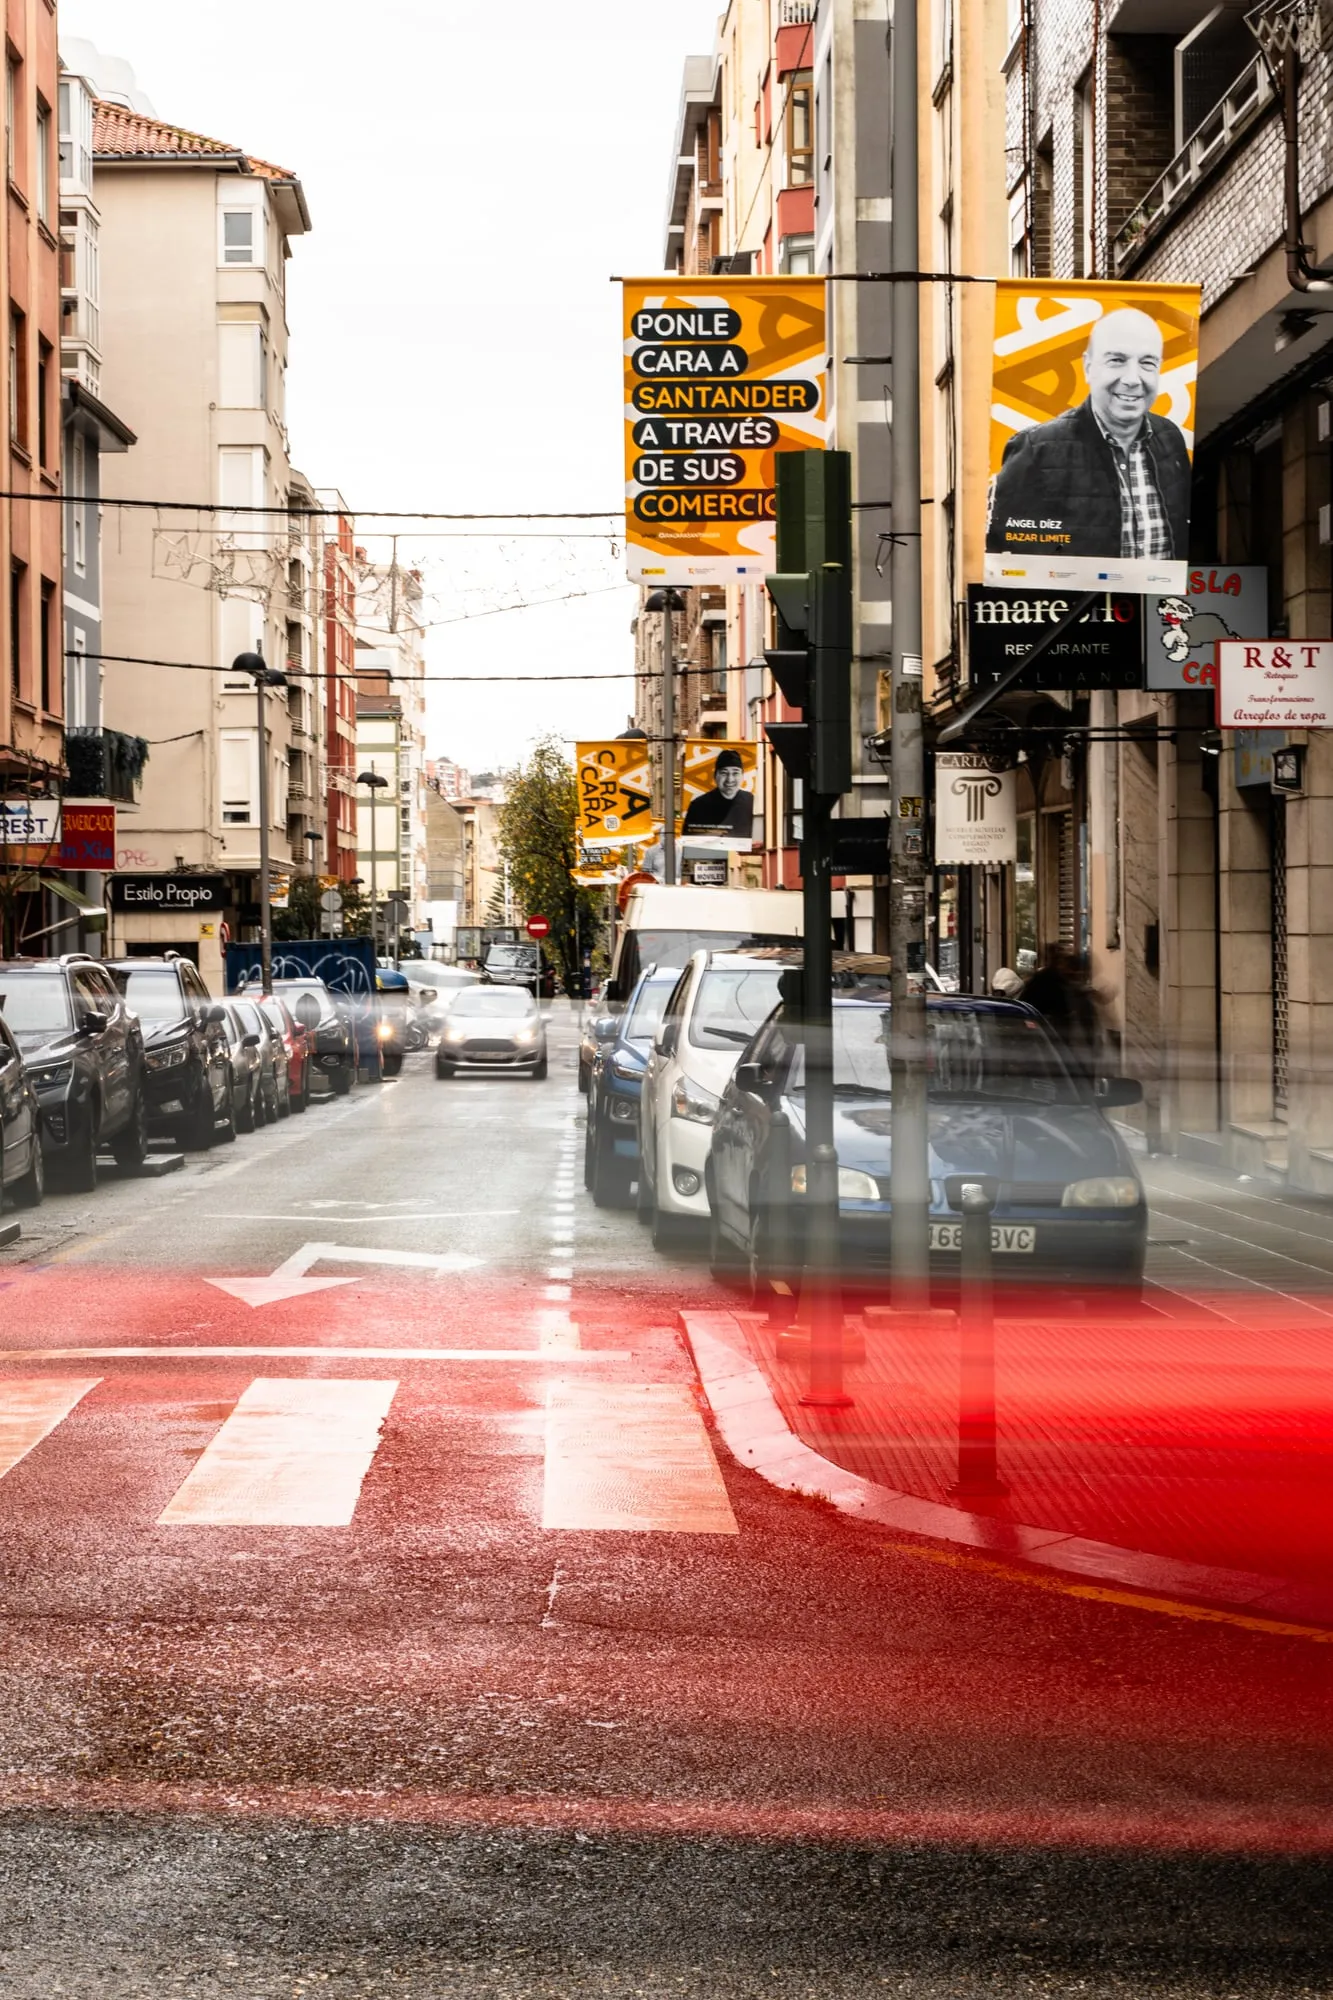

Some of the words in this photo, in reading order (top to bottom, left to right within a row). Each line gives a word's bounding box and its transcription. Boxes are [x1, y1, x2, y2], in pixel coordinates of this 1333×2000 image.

[637, 313, 729, 337] PONLE
[638, 350, 711, 373] CARA
[719, 350, 740, 372] A
[638, 385, 807, 410] SANTANDER
[639, 423, 659, 445] A
[665, 417, 772, 445] TRAVÉS
[639, 459, 675, 482] DE
[683, 458, 738, 481] SUS
[1005, 516, 1038, 529] ÁNGEL
[1039, 518, 1063, 530] DÍEZ
[1005, 532, 1038, 542] BAZAR
[1186, 570, 1242, 597] SLA
[1004, 642, 1111, 656] RESURANTE
[1243, 647, 1266, 669] R
[1271, 646, 1293, 669] &
[1300, 646, 1321, 669] T
[973, 671, 1137, 685] ITLIANO
[1263, 671, 1299, 681] Retoques
[1233, 708, 1281, 724] Arreglos
[1284, 709, 1298, 721] de
[1300, 713, 1327, 724] ropa
[597, 750, 618, 813] CARA
[580, 766, 602, 829] CARA
[0, 818, 49, 834] REST
[124, 881, 164, 901] Estilo
[166, 883, 213, 908] Propio
